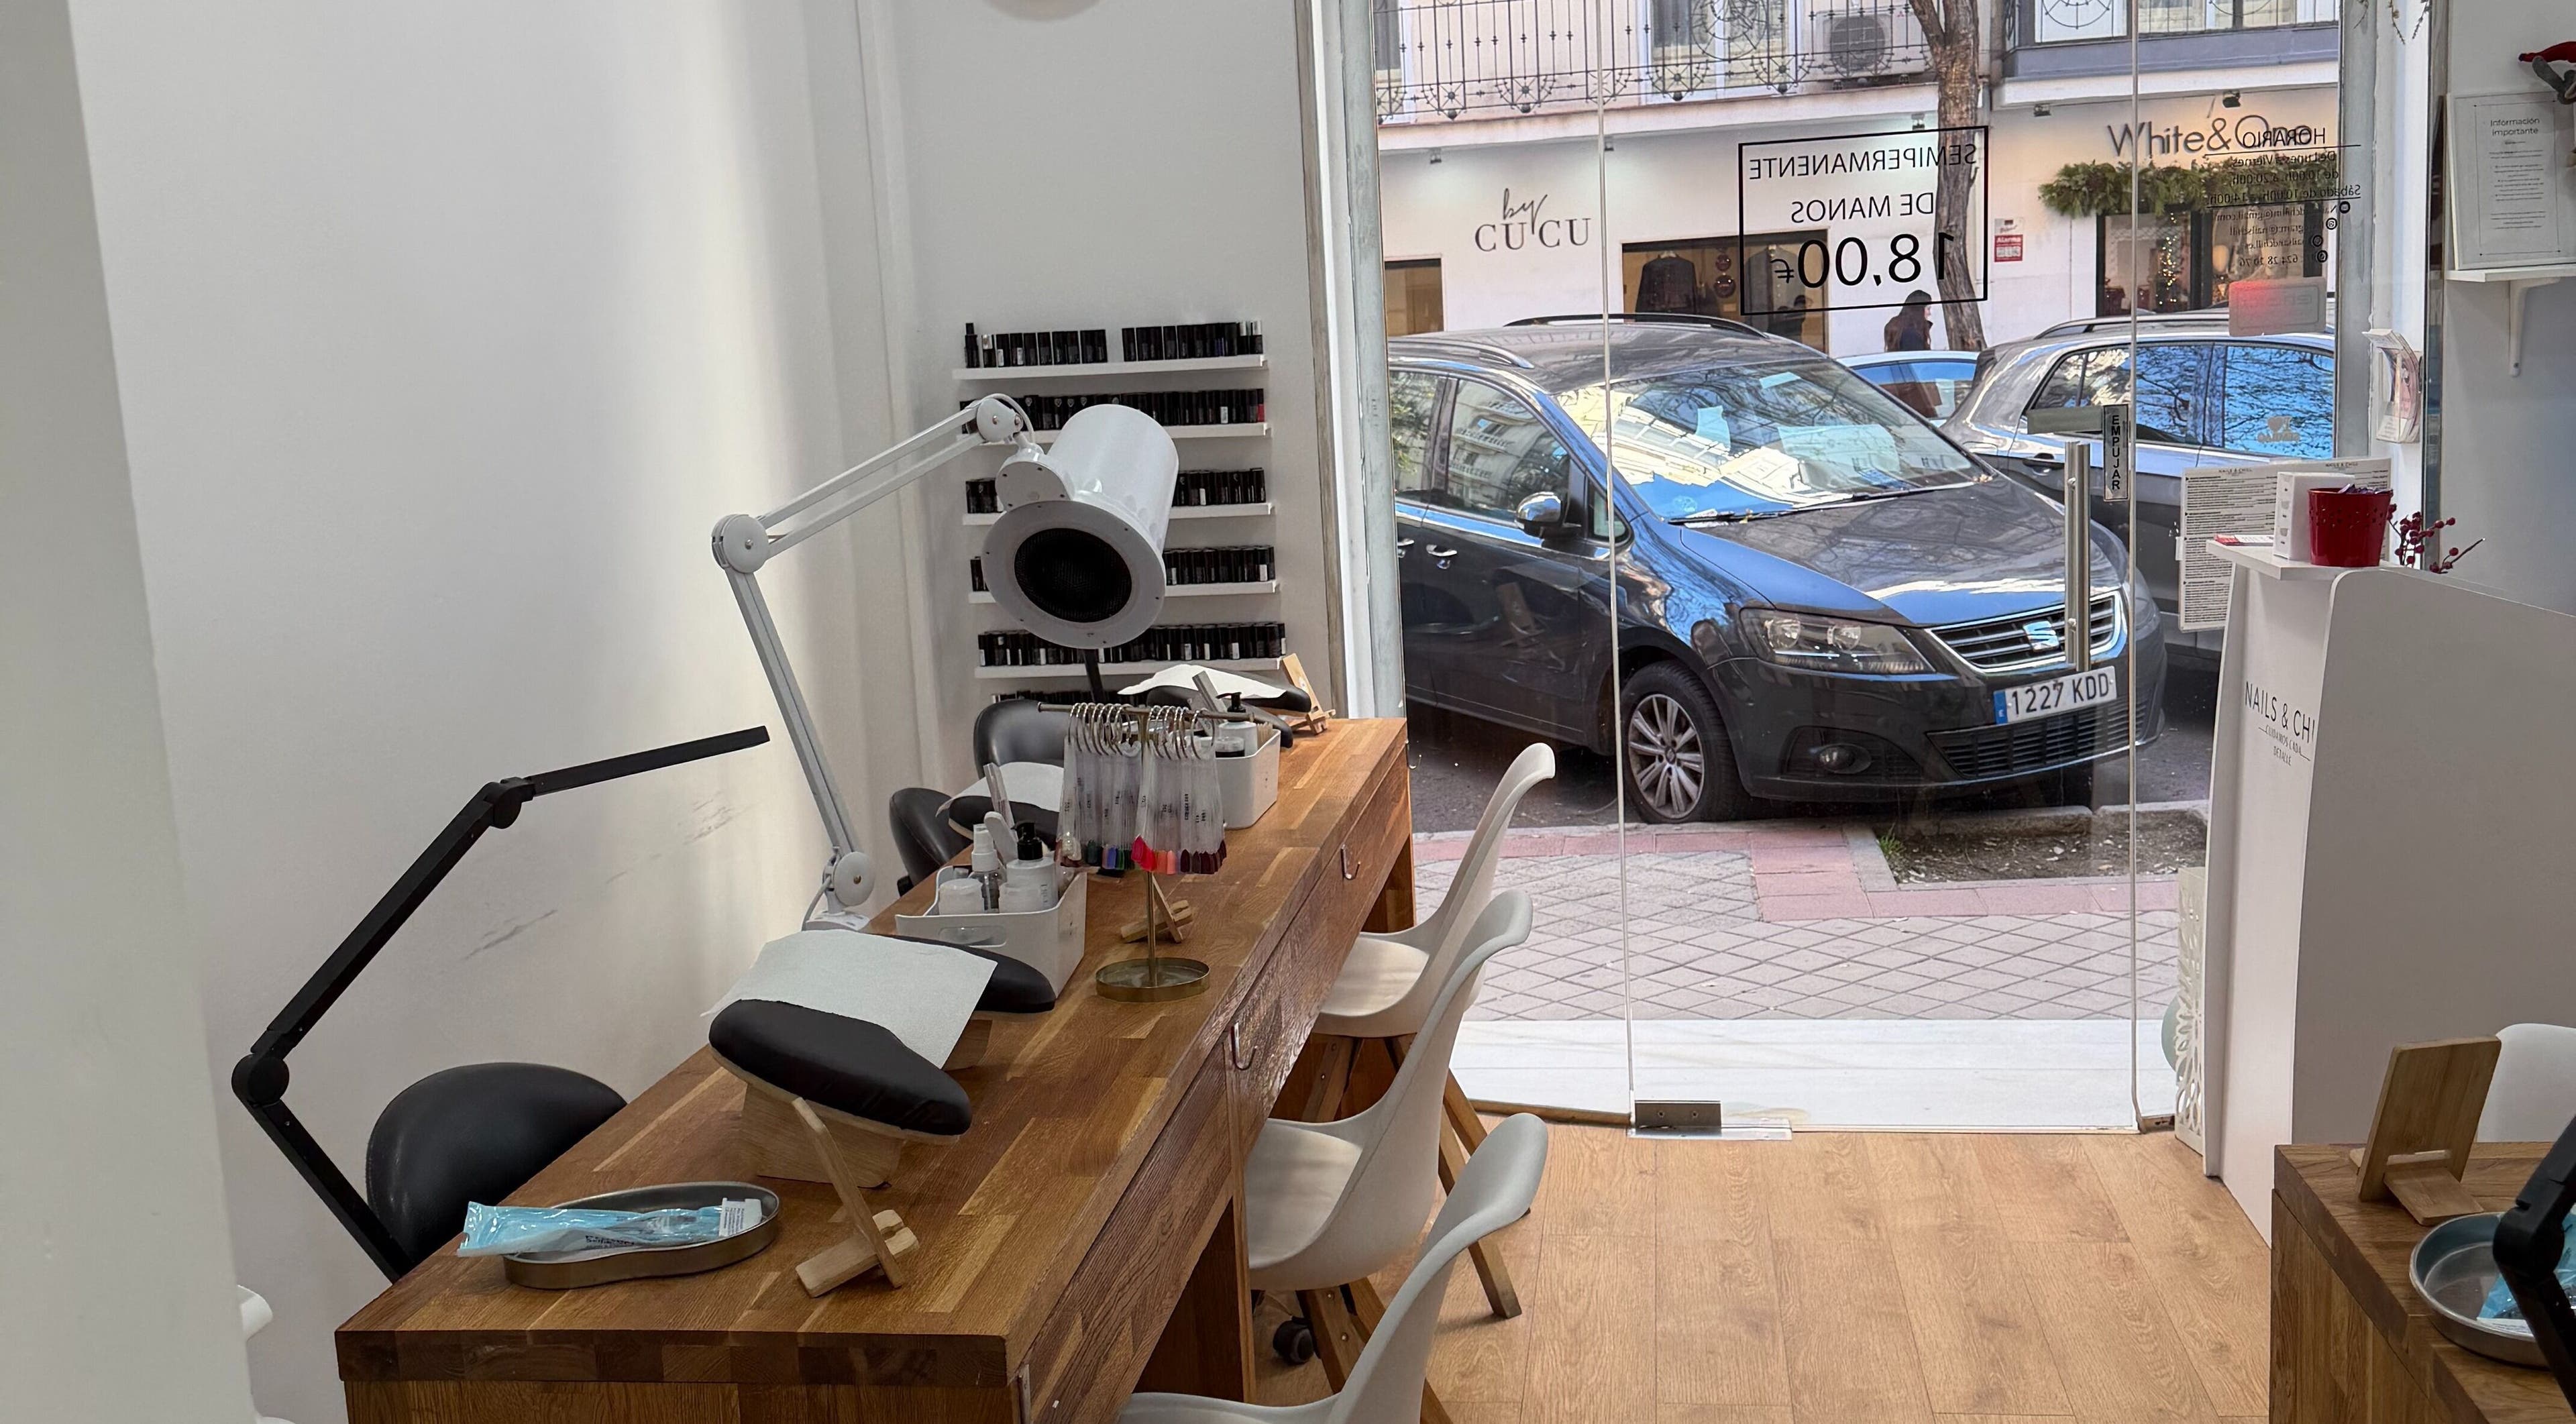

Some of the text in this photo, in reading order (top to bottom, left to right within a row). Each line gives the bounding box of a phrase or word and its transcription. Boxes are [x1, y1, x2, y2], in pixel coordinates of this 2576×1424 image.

[2490, 118, 2540, 127] Información
[1503, 187, 1548, 235] by
[1474, 218, 1592, 252] CUCU
[2110, 415, 2121, 490] EMPUJAR
[2012, 673, 2109, 716] 1227 KDD
[2245, 681, 2277, 722] NAILS
[2282, 703, 2288, 730] &
